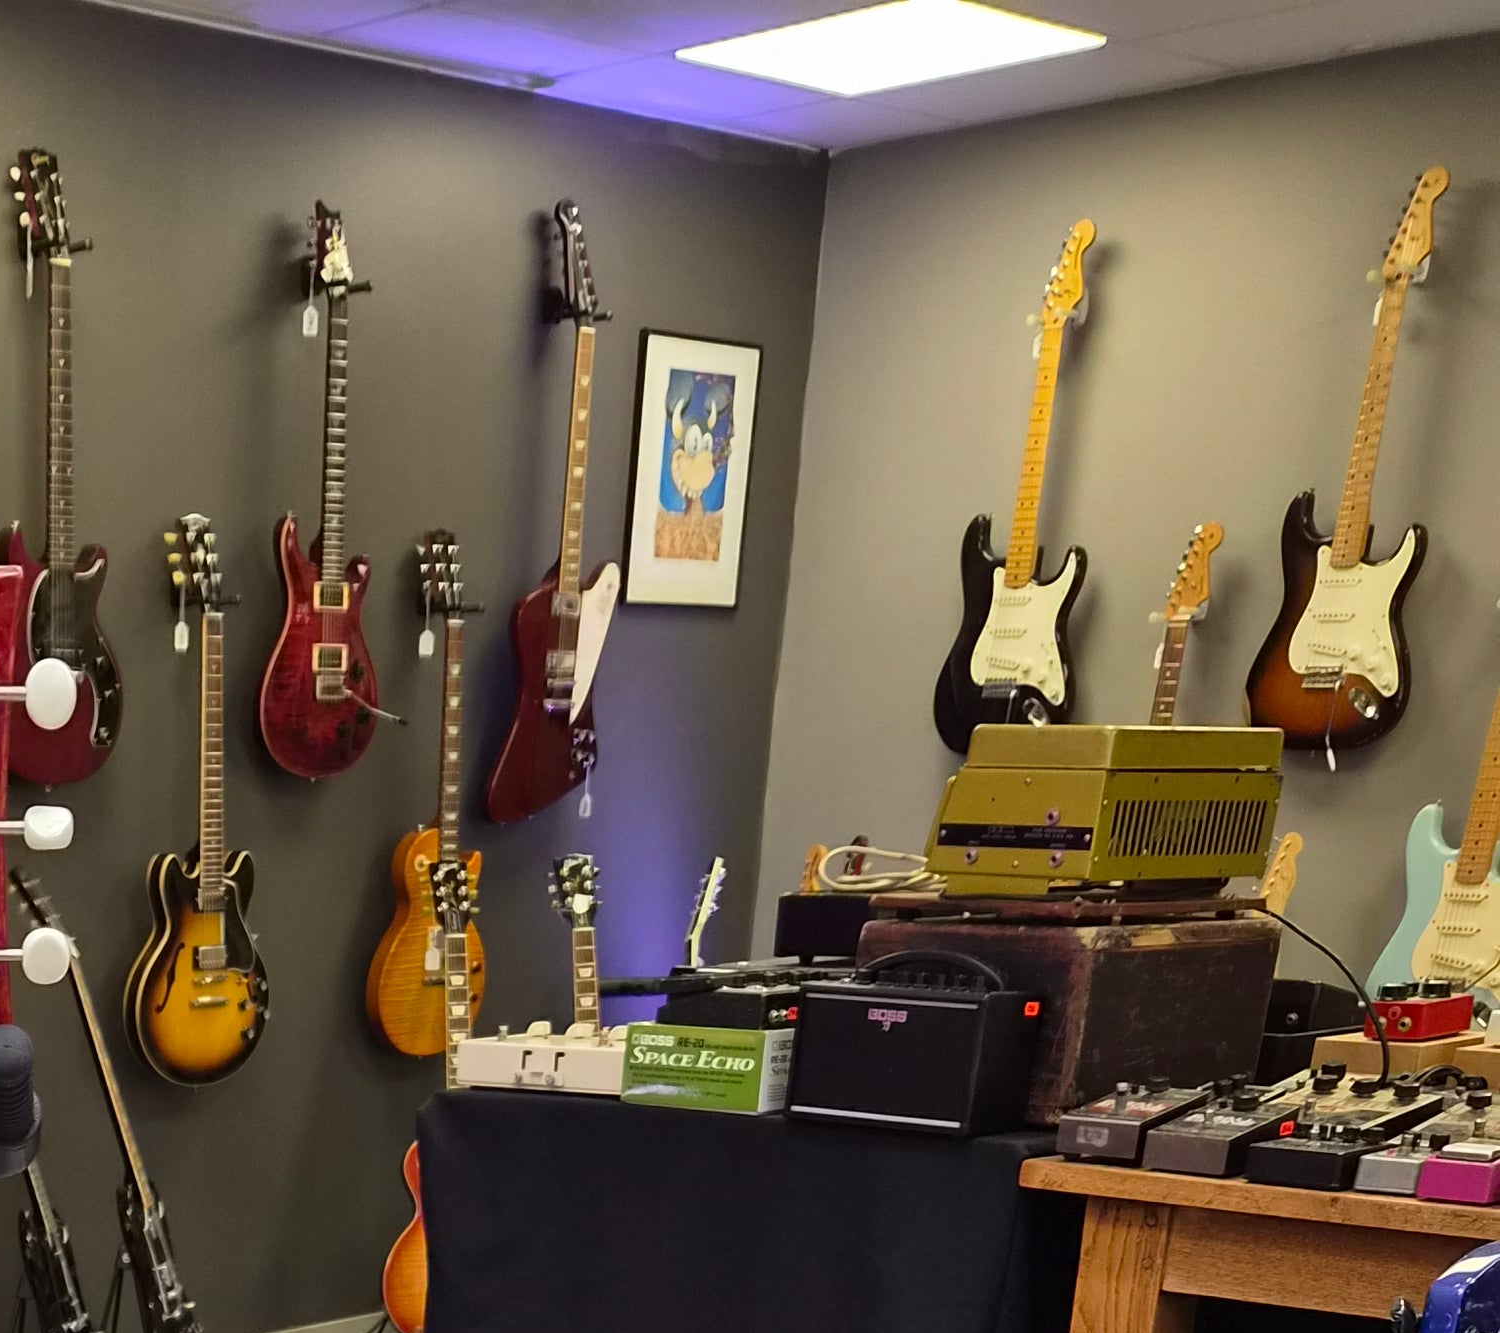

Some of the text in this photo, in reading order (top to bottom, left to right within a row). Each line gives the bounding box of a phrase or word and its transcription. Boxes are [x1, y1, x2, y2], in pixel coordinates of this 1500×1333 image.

[868, 1008, 908, 1023] BOSS
[640, 1034, 675, 1047] BOSS
[677, 1036, 705, 1048] RE-20
[630, 1046, 693, 1067] SPACE
[695, 1050, 756, 1072] ECHO
